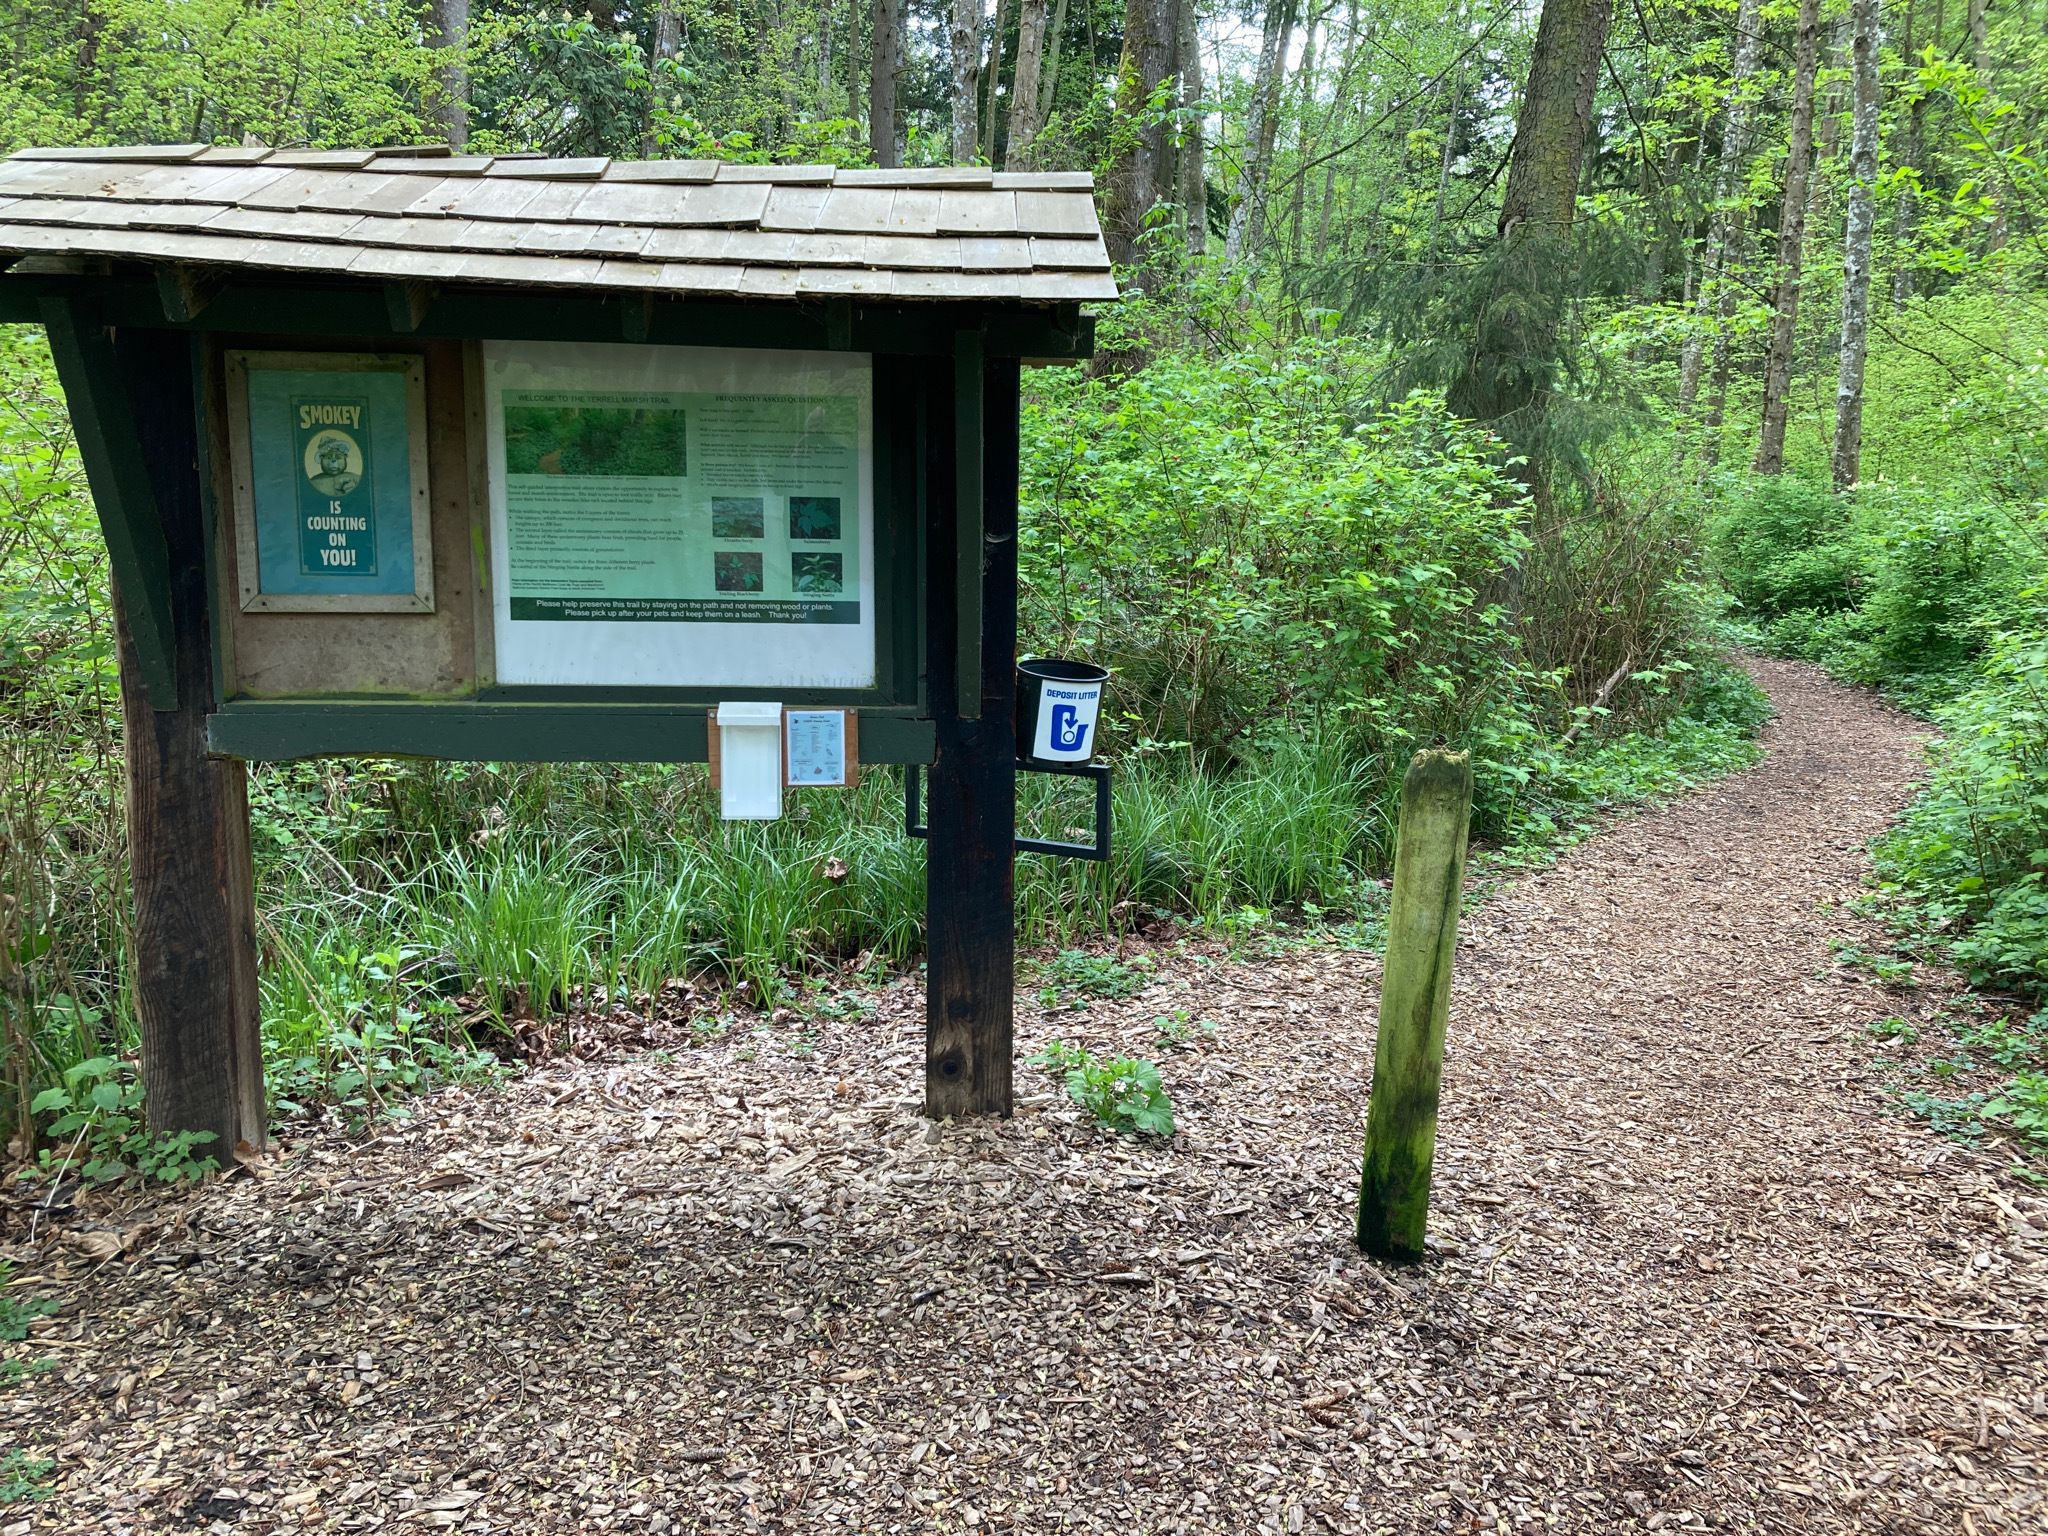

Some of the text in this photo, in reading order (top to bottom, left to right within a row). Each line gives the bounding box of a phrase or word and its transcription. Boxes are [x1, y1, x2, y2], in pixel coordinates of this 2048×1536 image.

[300, 405, 361, 430] SMOKEY
[329, 500, 342, 515] IS
[307, 516, 367, 531] COUNTING
[329, 533, 346, 547] ON
[320, 549, 356, 566] YOU!
[562, 600, 578, 609] help
[580, 601, 611, 610] preserve
[642, 601, 651, 610] by
[652, 602, 677, 610] staying
[703, 602, 719, 610] path
[748, 604, 780, 612] removing
[592, 610, 606, 618] pick
[653, 611, 669, 620] pets
[671, 610, 684, 618] and
[686, 610, 703, 619] keep
[791, 612, 807, 621] you!
[1046, 689, 1098, 700] DEPOSIT LITTER
